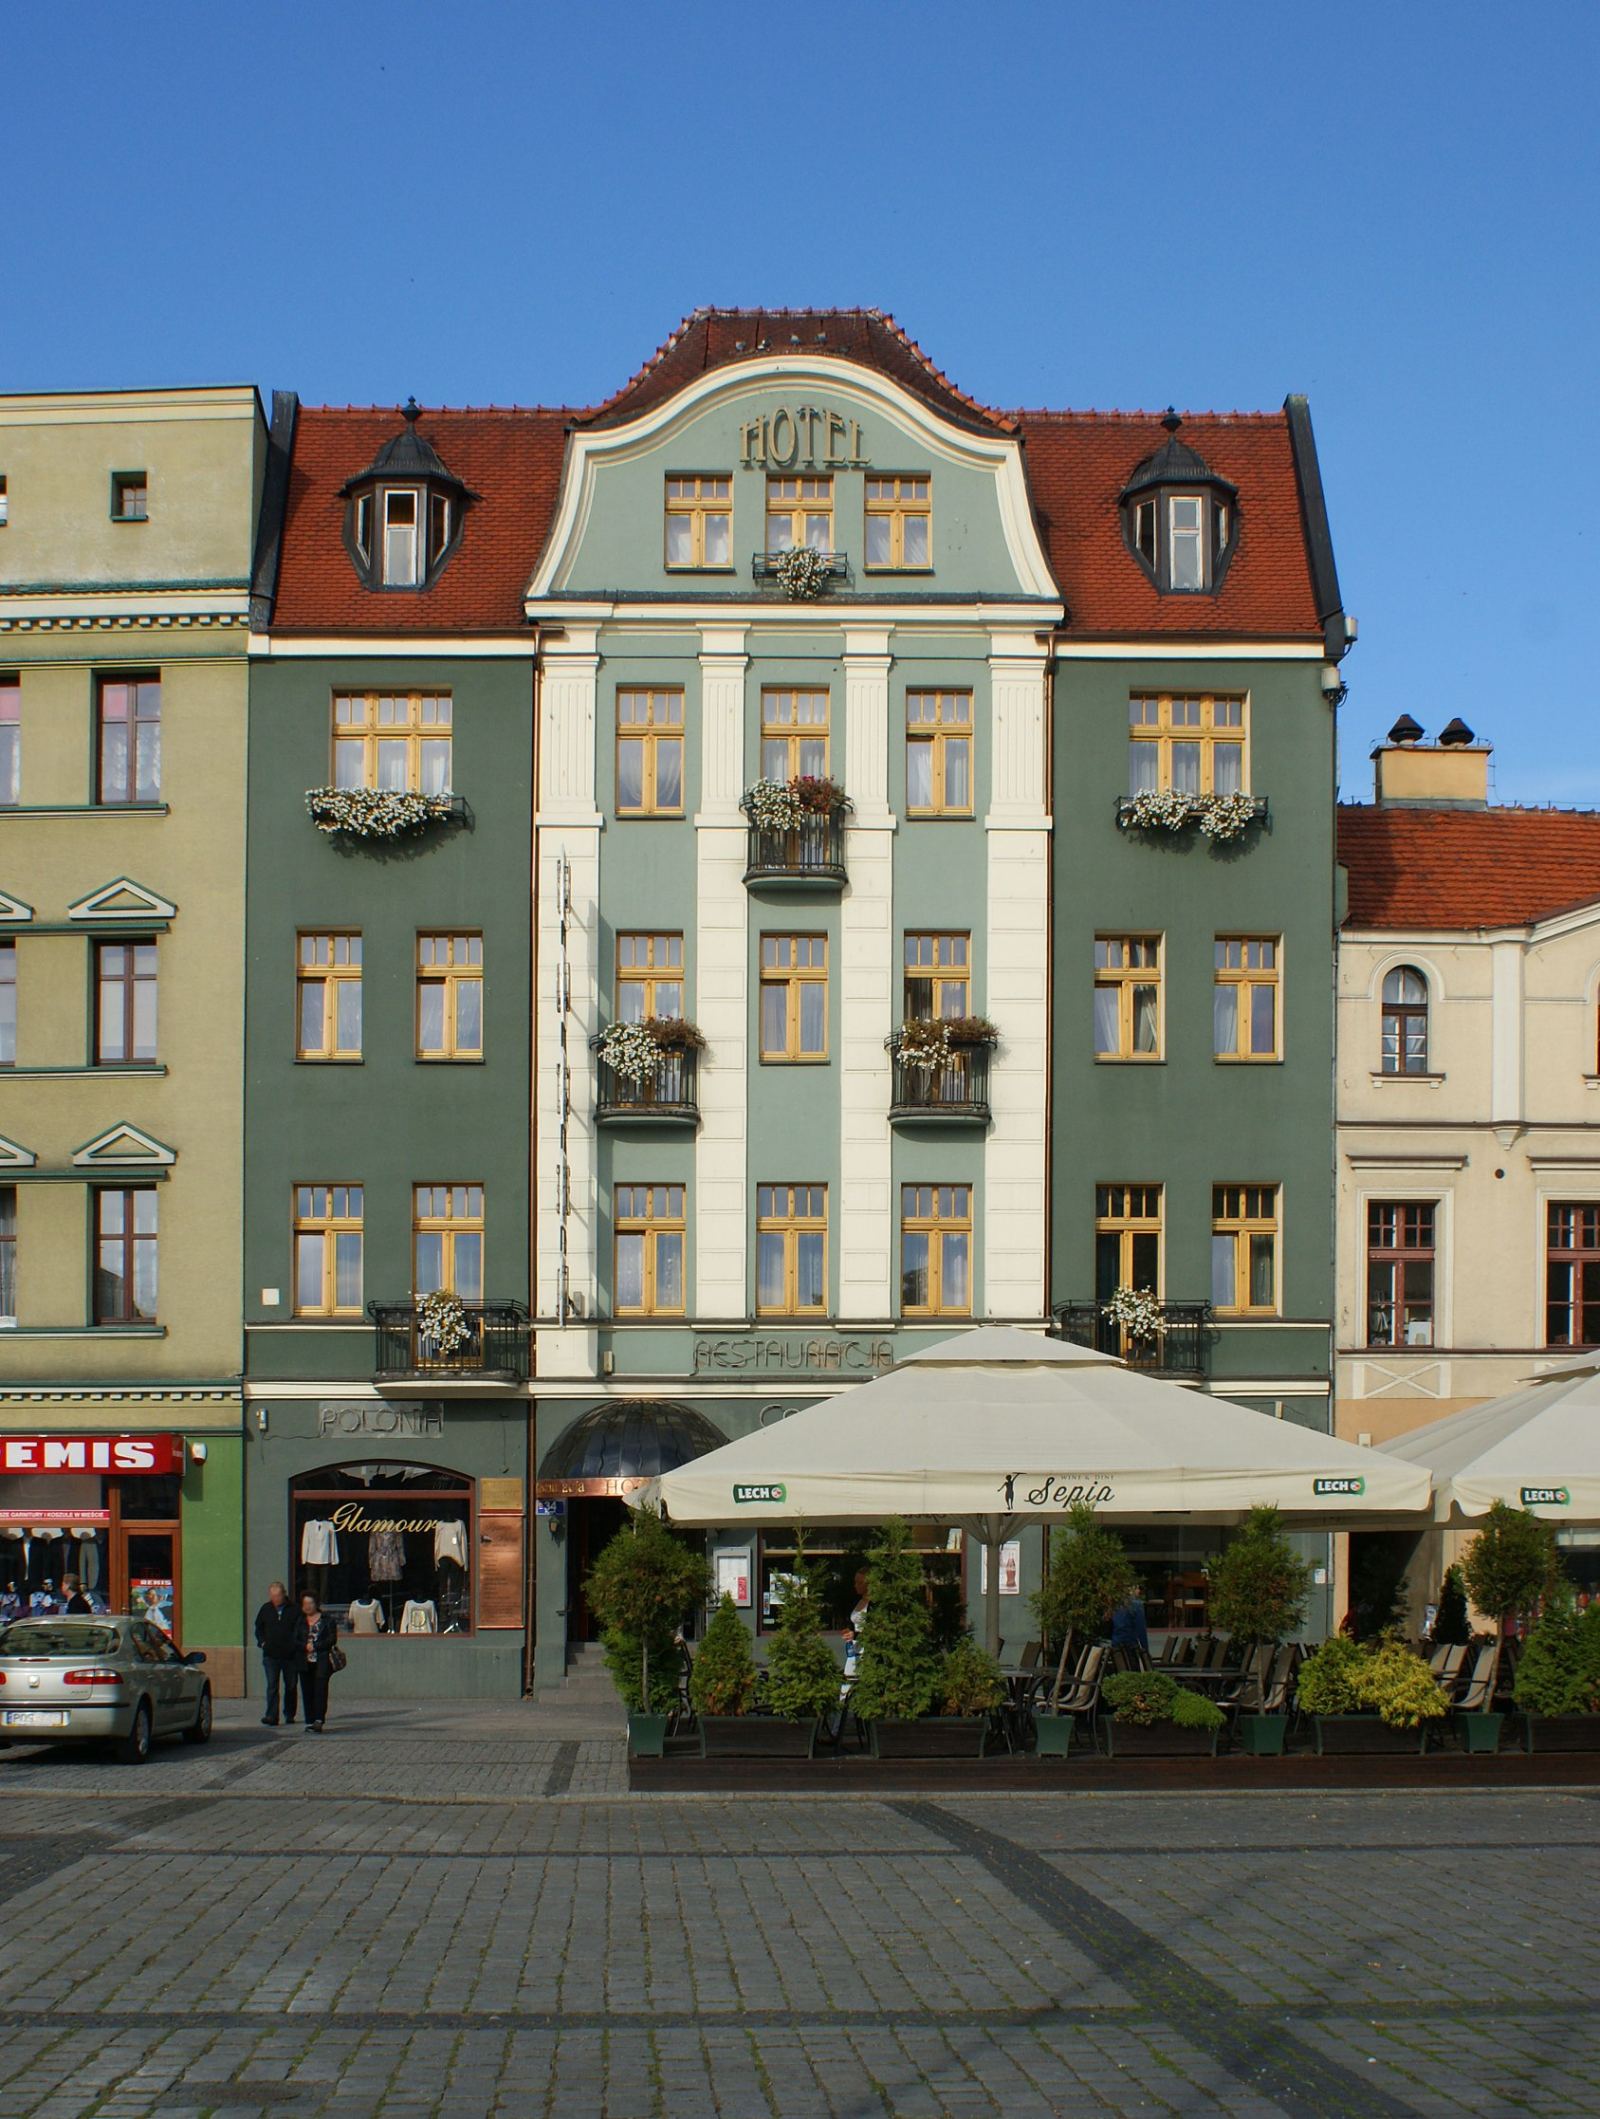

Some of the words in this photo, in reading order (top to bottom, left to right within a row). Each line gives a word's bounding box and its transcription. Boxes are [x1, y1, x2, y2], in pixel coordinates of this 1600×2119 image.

[739, 405, 872, 465] HOTEL
[692, 1340, 894, 1369] RESTAURACJA
[321, 1408, 443, 1434] POLONIA
[0, 1442, 155, 1468] EMIS
[737, 1487, 770, 1499] LECH
[1024, 1476, 1115, 1508] Sepia
[1317, 1481, 1349, 1491] LECH
[1524, 1490, 1555, 1501] LECH
[328, 1502, 439, 1533] Glamour
